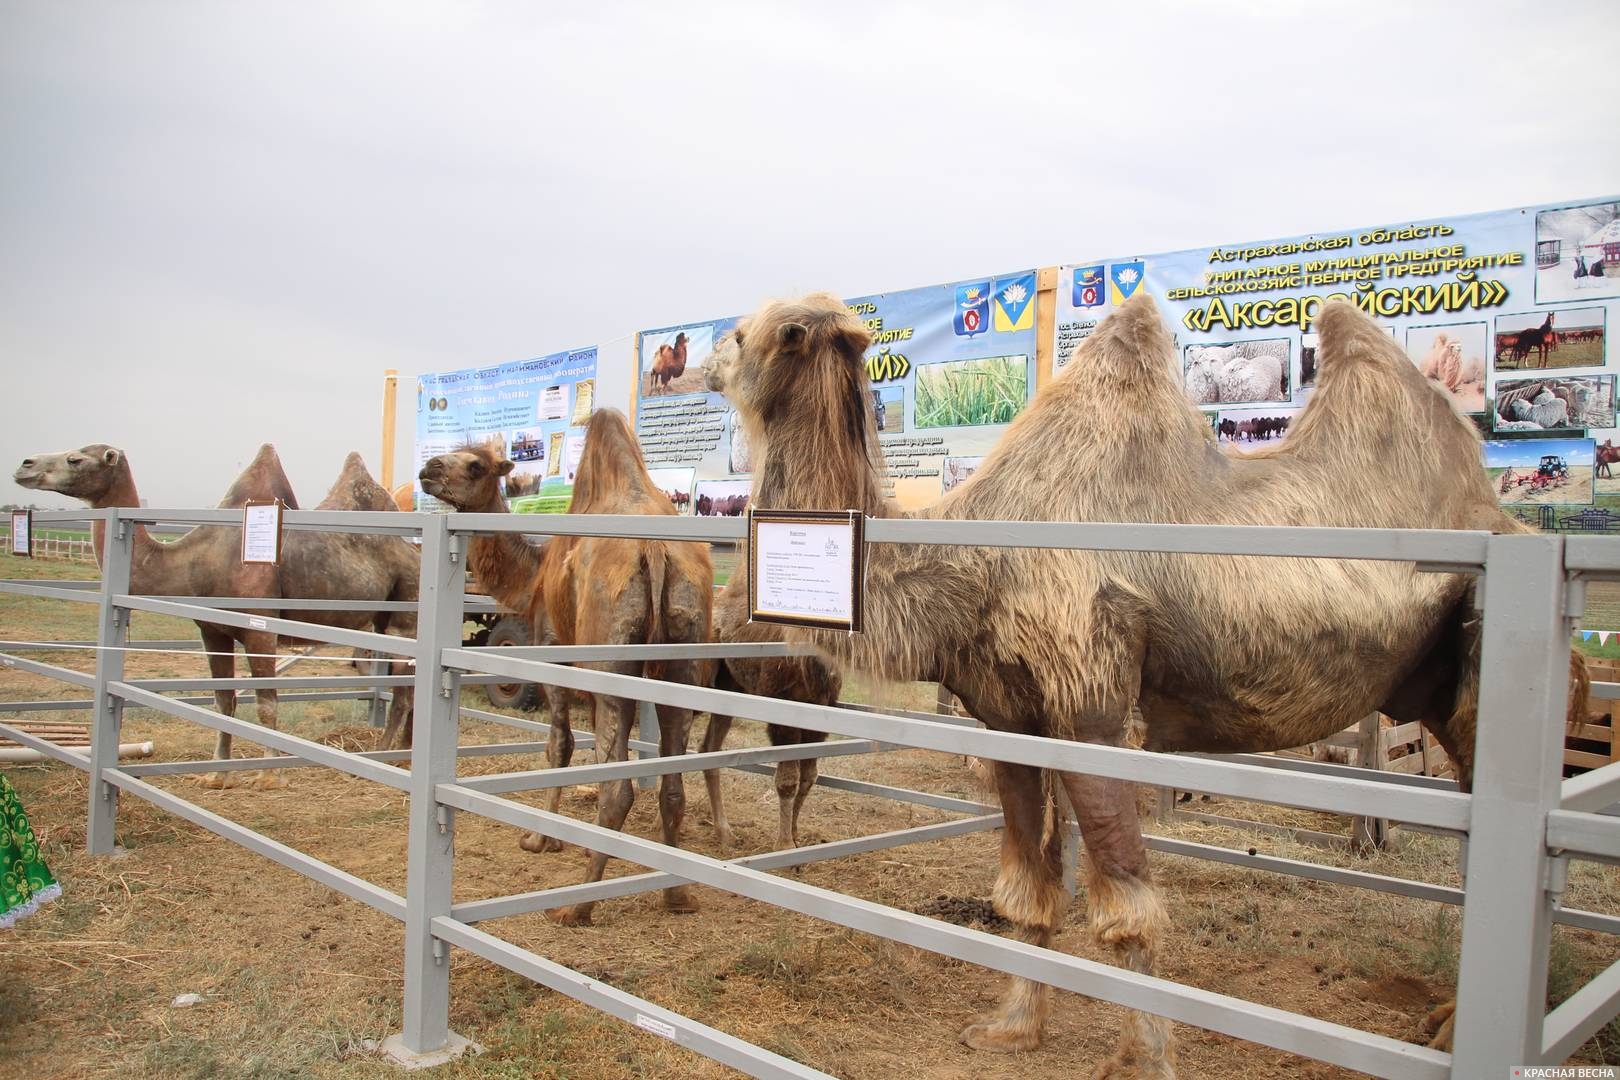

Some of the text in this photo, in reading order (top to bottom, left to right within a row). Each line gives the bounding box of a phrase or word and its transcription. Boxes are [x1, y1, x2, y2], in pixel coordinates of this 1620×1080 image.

[1207, 223, 1453, 263] Астраханская область
[1165, 251, 1524, 300] СЕЛЬСКОХОЗЯЙСТВЕННОЕ ПРЕДПРИЯТИЕ
[1204, 244, 1464, 284] УНИТАРНОЕ МУНИЦИПАЛЬНОЕ
[872, 328, 914, 344] РИЯТИЕ
